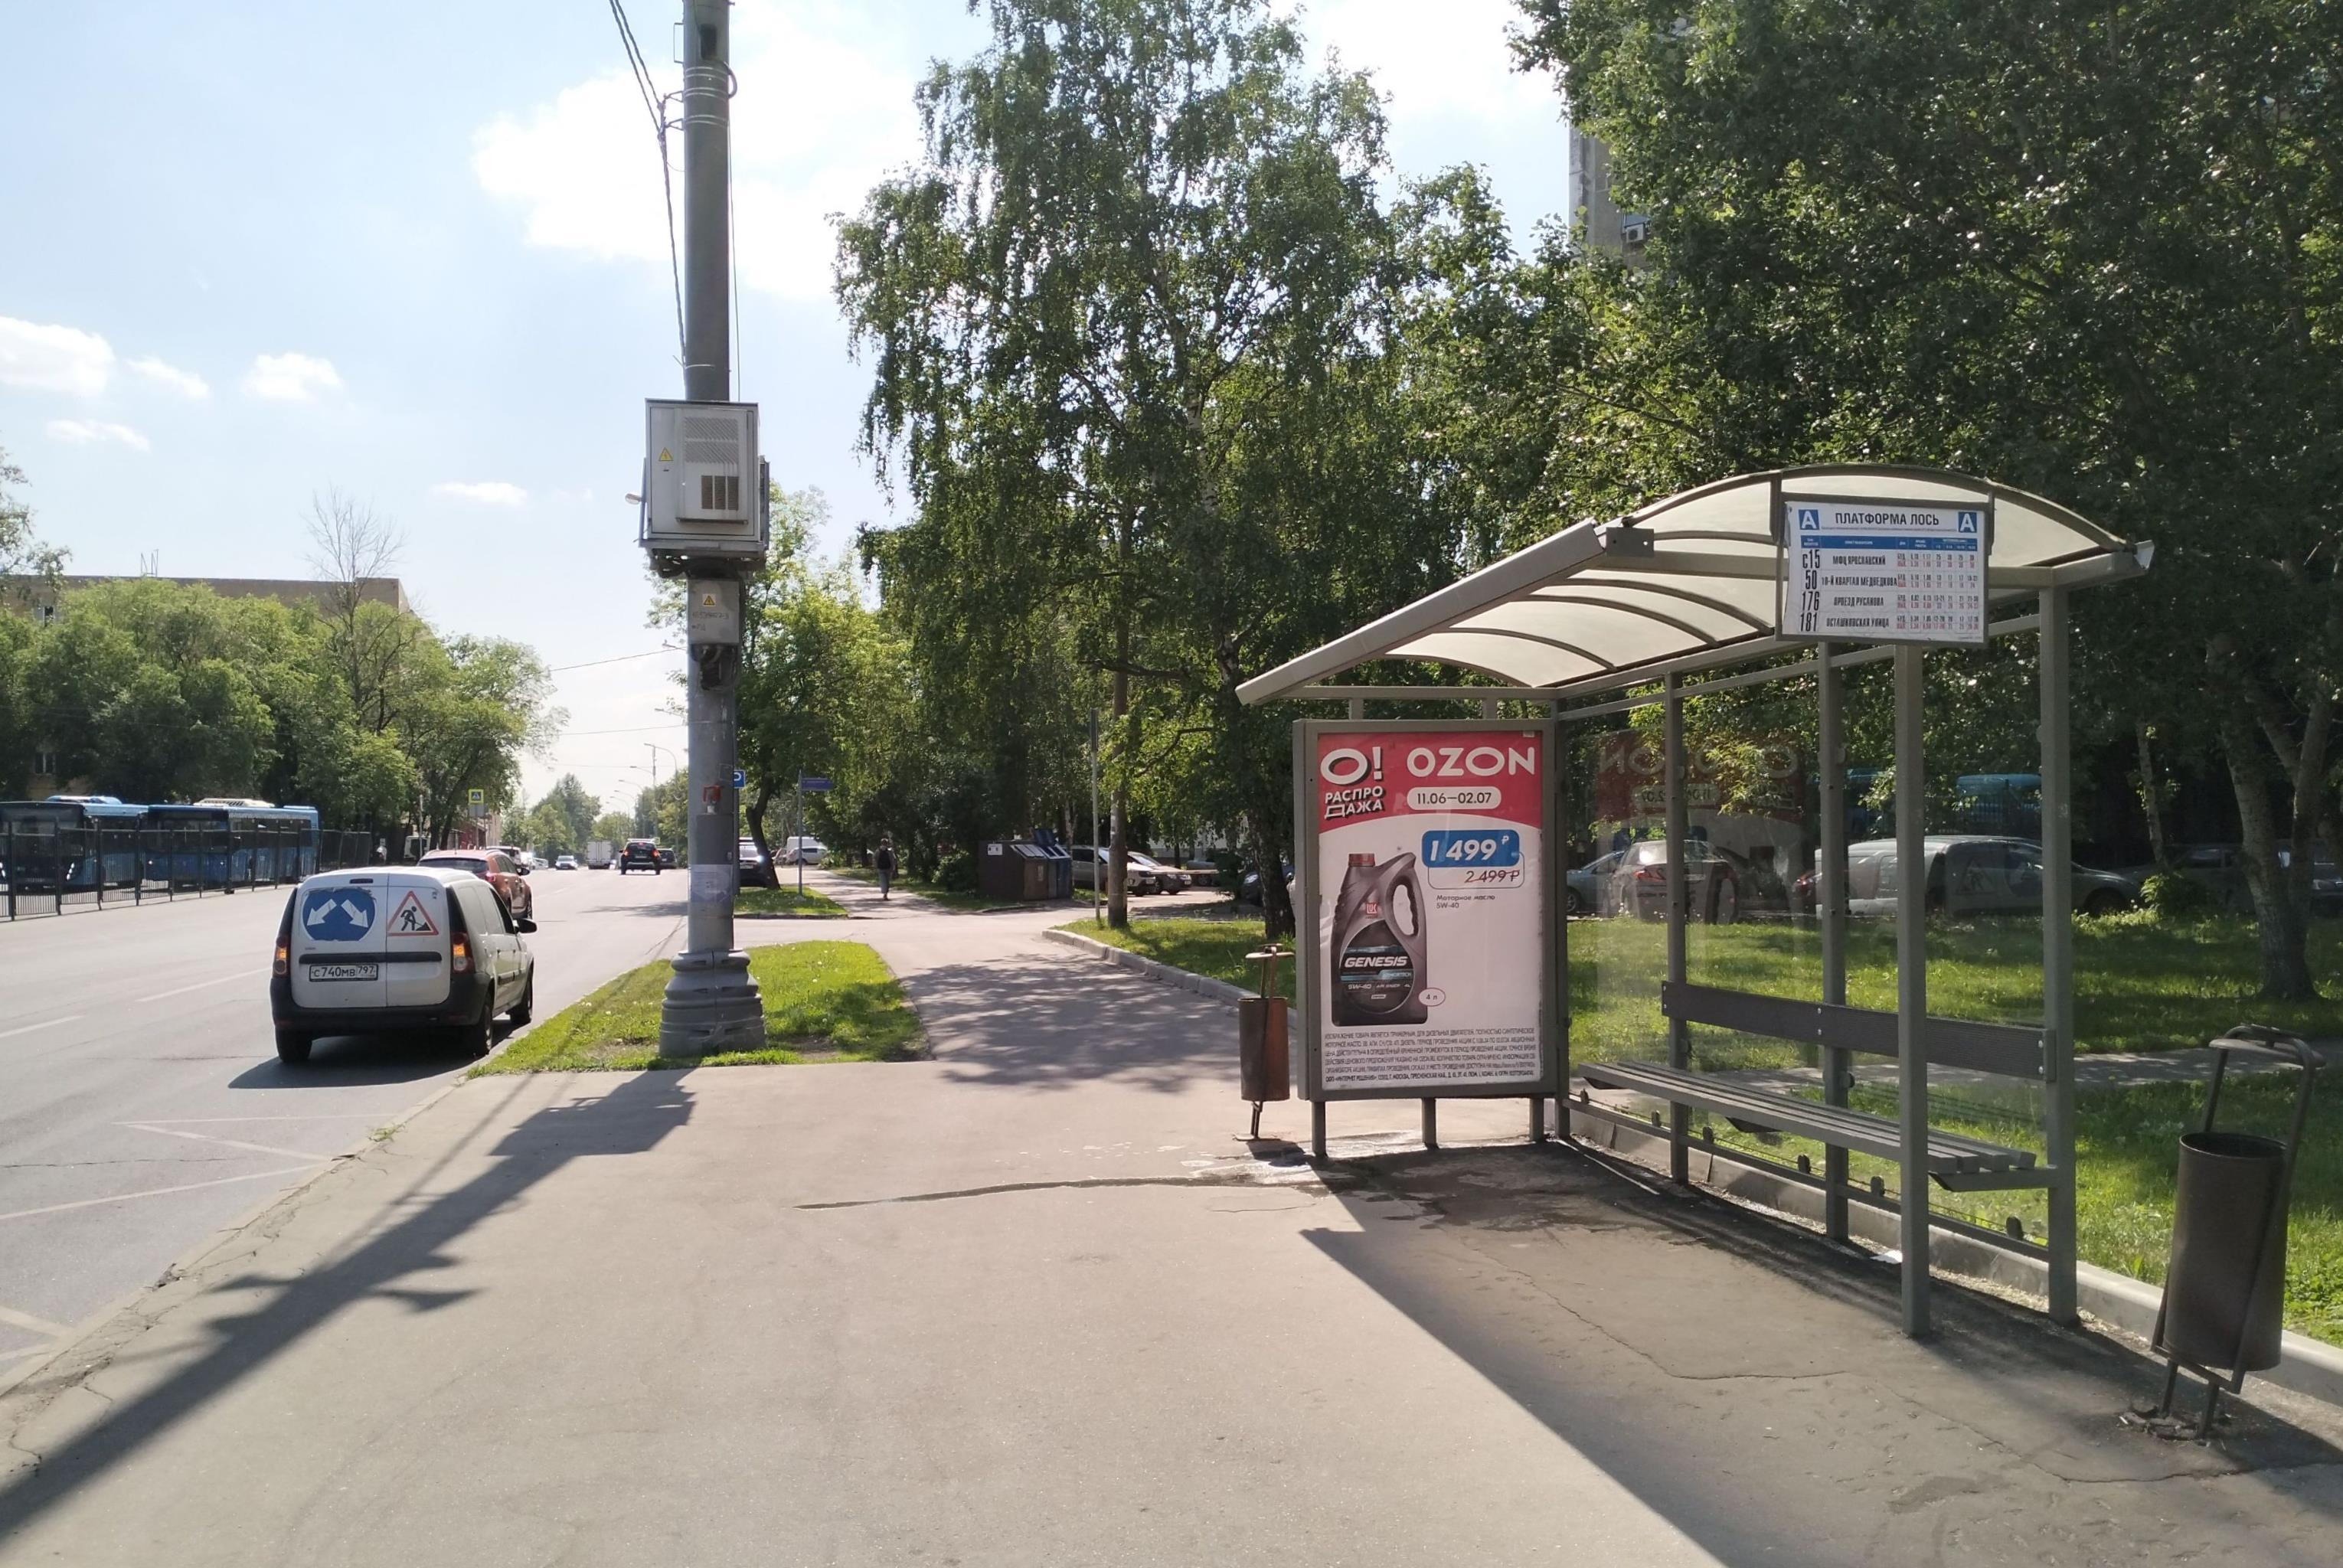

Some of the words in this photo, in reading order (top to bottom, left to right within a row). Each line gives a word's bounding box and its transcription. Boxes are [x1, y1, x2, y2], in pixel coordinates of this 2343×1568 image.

[1835, 512, 1907, 526] ПЛАТФОРМА
[1910, 514, 1939, 526] ЛОСЬ
[1802, 549, 1820, 569] с15
[1805, 570, 1818, 590] 50
[1801, 591, 1820, 611] 176
[1800, 612, 1818, 632] 181
[1407, 746, 1535, 777] OZON
[1325, 786, 1384, 805] РАСПРО
[1324, 799, 1383, 820] ДАЖА
[358, 965, 375, 975] 797
[1344, 956, 1408, 969] GENESIS
